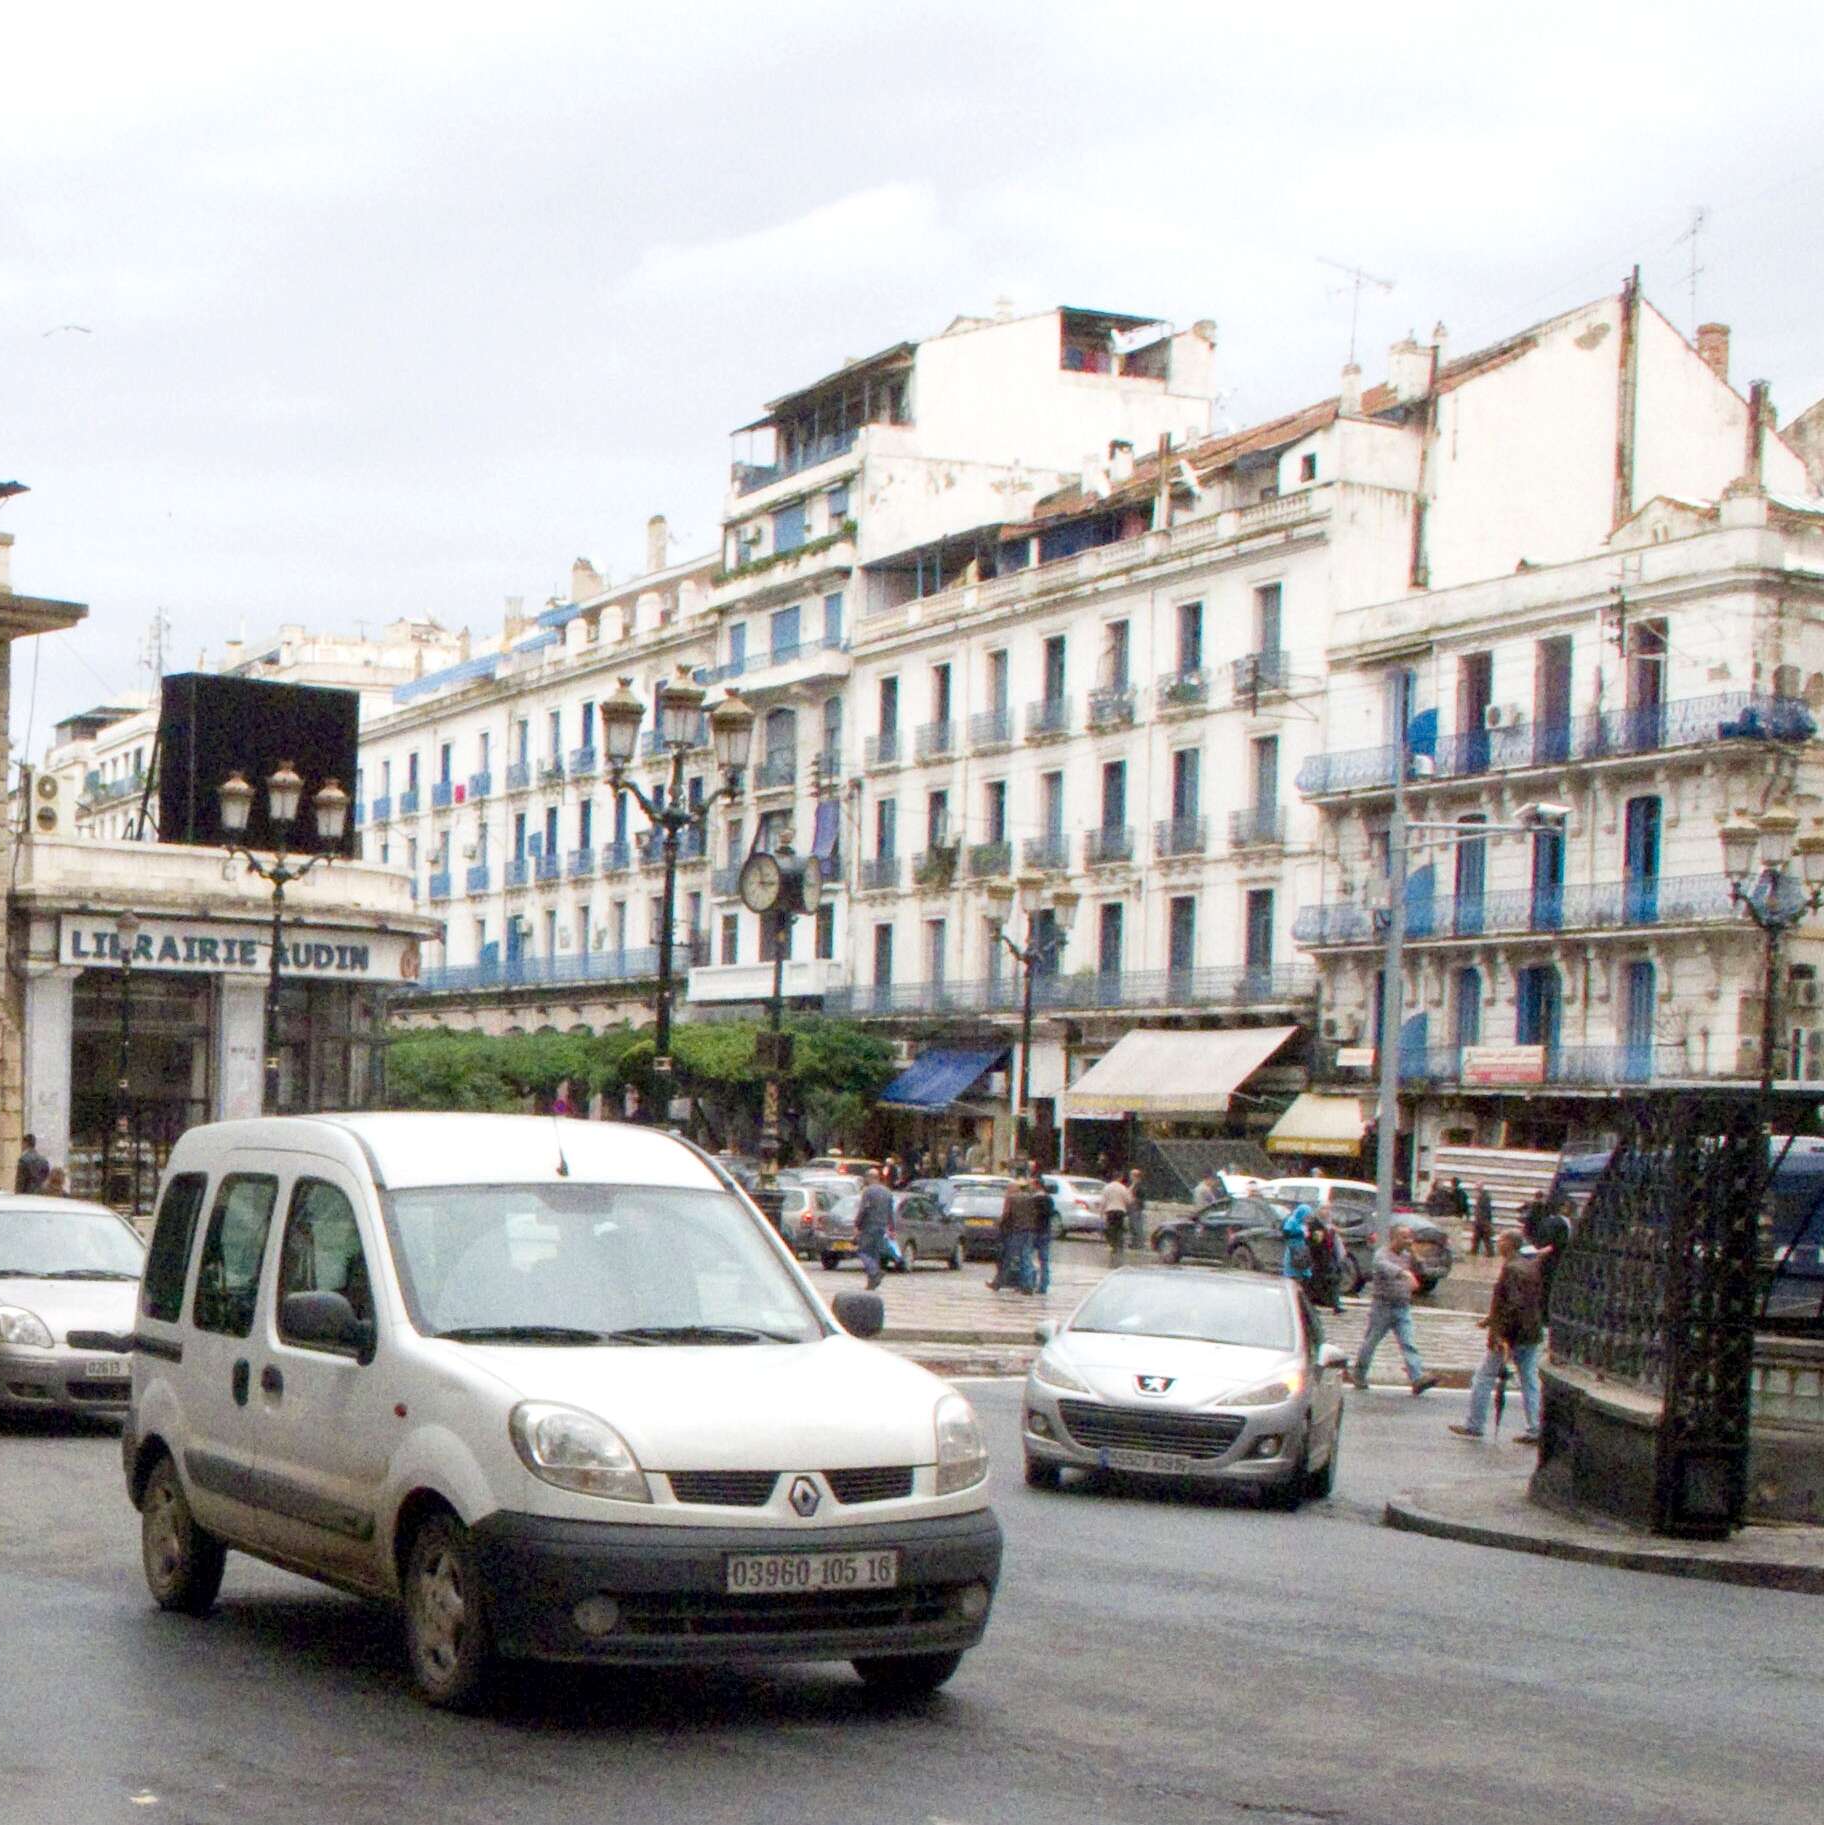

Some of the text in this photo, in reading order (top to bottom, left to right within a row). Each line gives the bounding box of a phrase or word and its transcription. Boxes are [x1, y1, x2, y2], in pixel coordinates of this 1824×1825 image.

[732, 1555, 891, 1587] 03960 105 16
